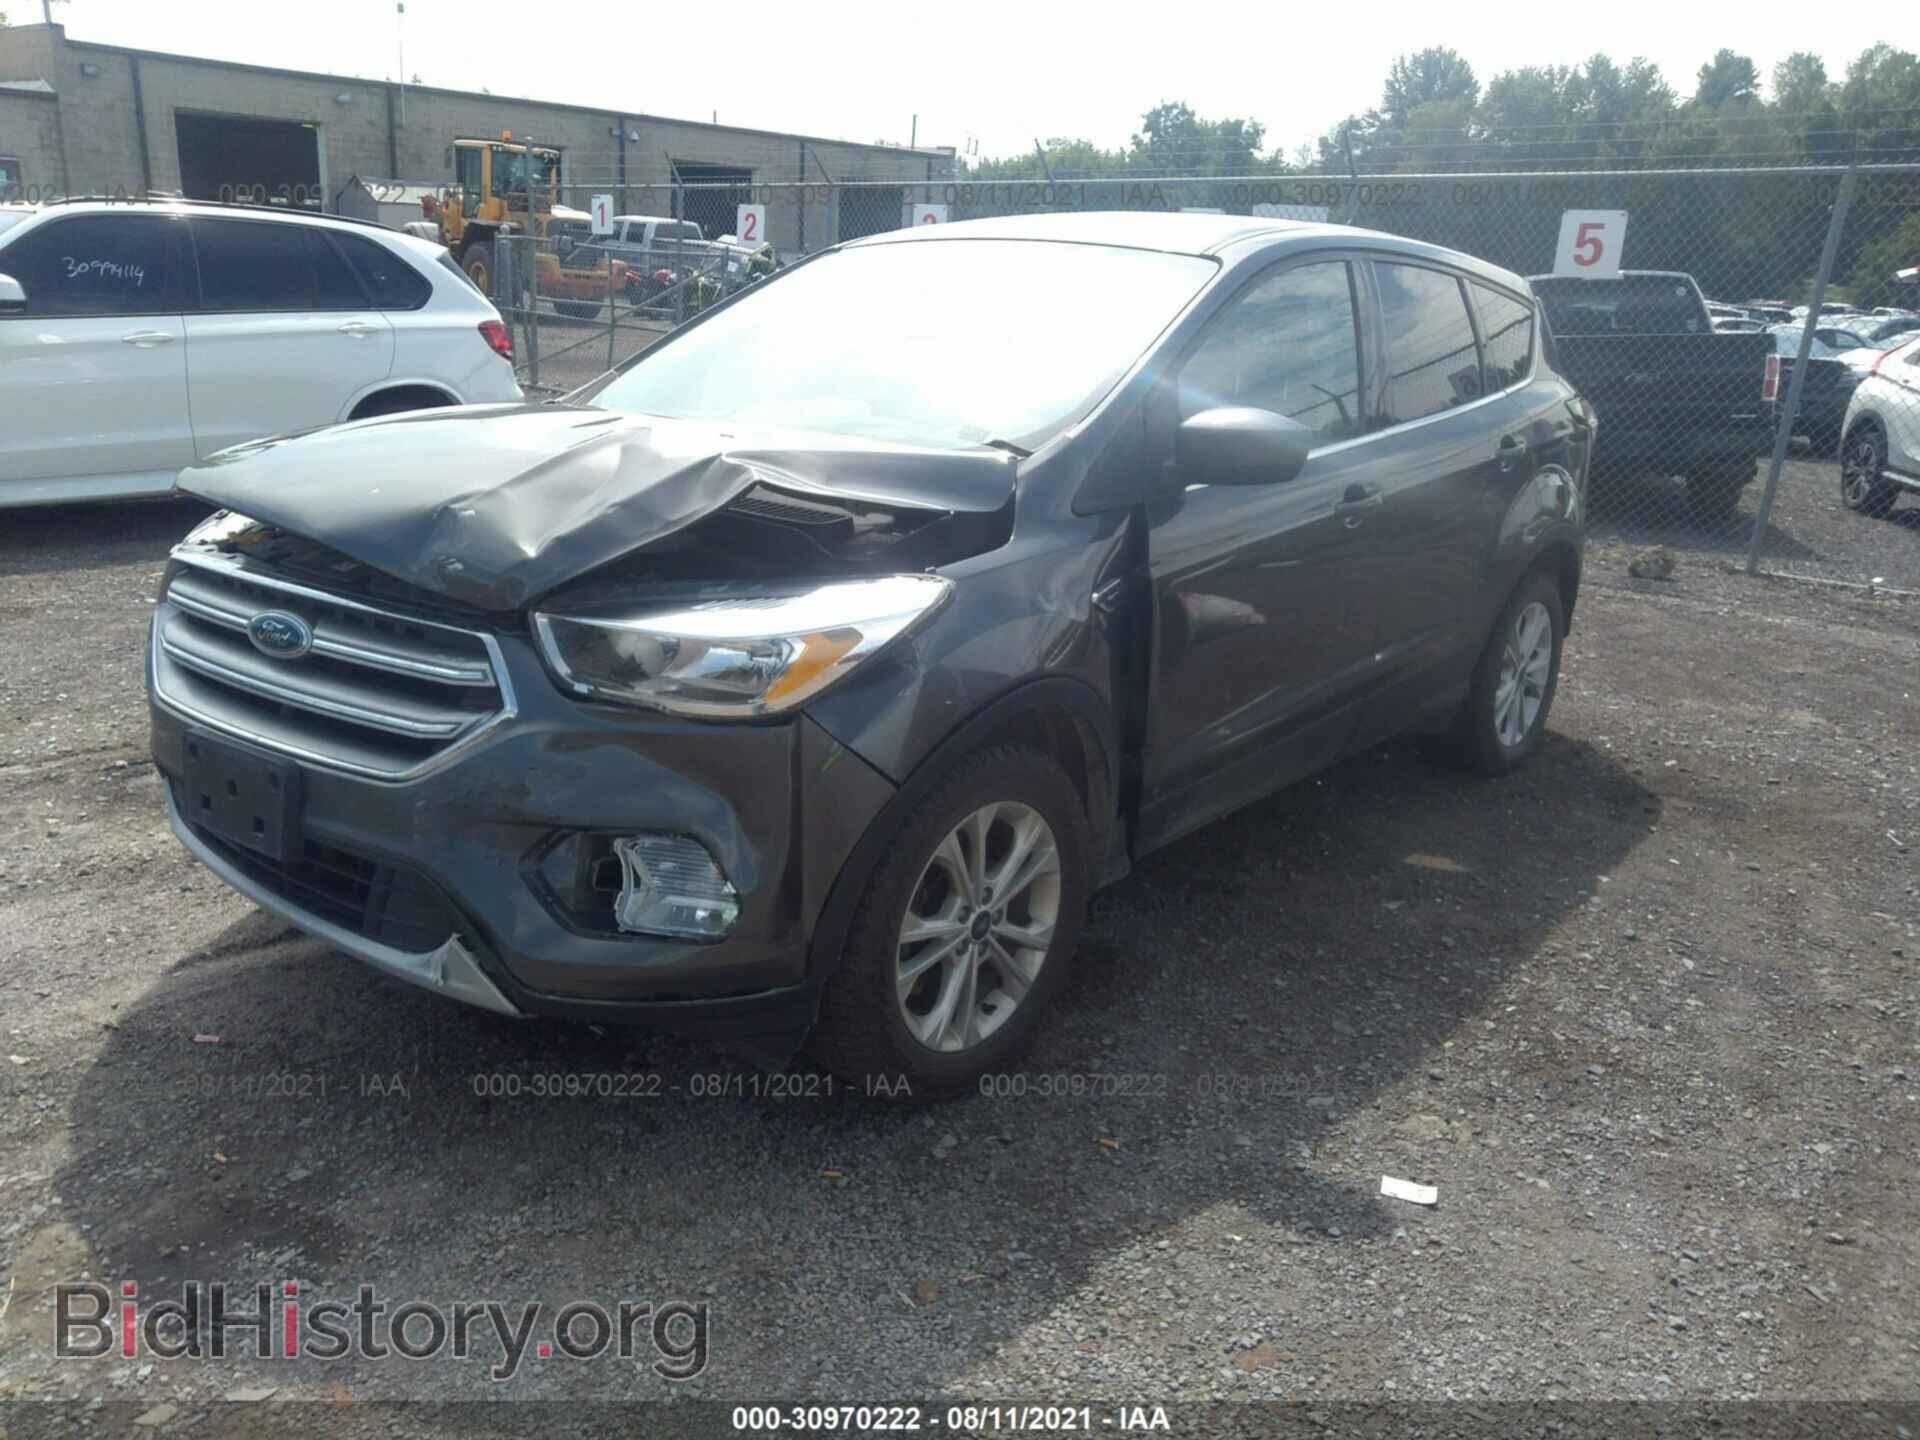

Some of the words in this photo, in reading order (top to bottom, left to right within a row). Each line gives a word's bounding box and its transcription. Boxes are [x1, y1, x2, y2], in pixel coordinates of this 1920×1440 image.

[597, 202, 607, 228] 1
[743, 212, 757, 241] 2
[1573, 223, 1606, 267] 5
